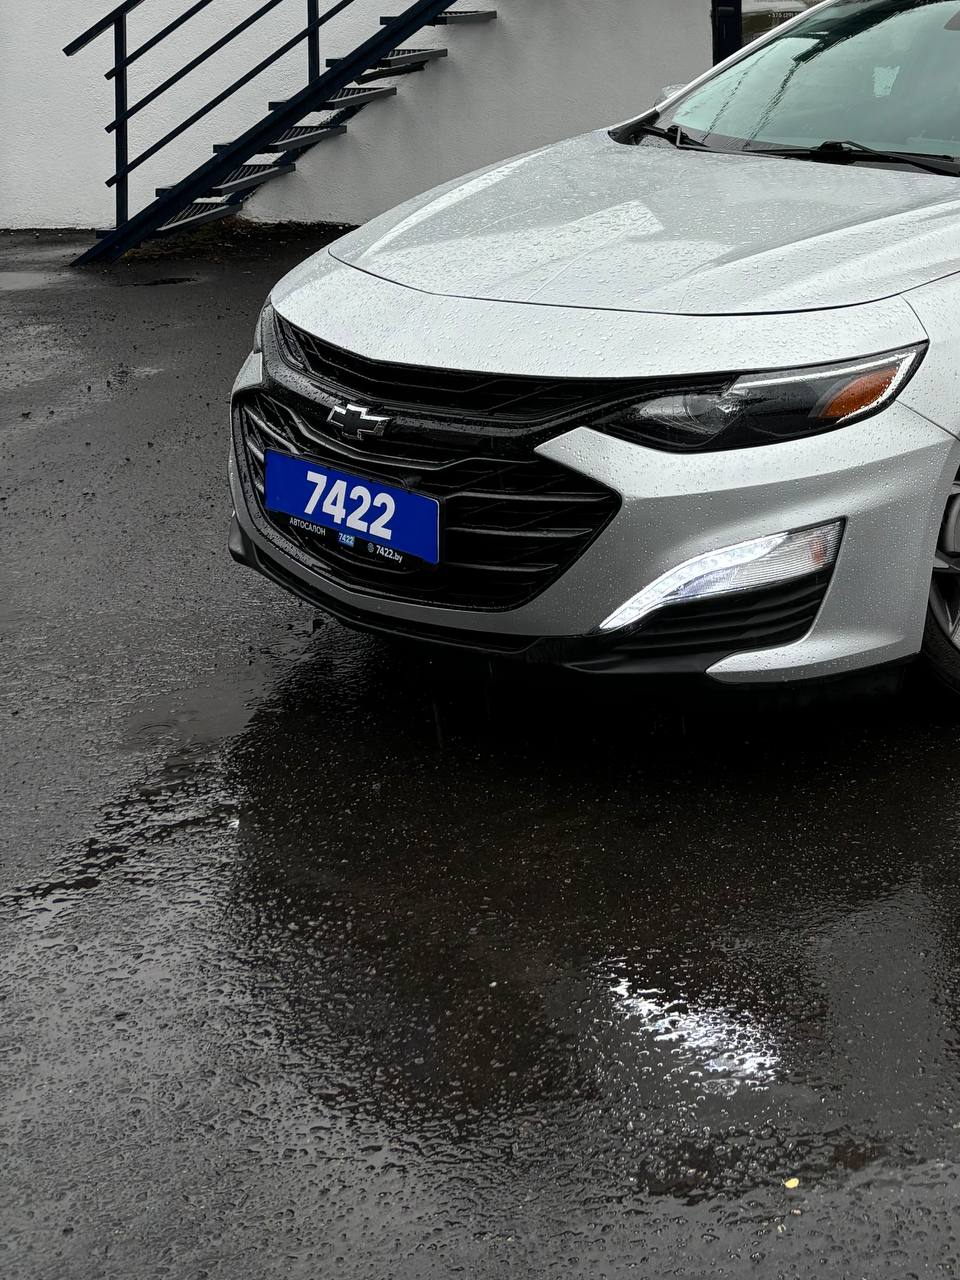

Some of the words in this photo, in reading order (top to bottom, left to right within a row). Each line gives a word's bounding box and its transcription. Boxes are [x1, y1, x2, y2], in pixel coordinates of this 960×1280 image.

[304, 470, 395, 540] 7422
[289, 517, 326, 536] АВТОСАЛОН
[338, 532, 355, 545] 7422
[376, 545, 403, 563] 7422.by
